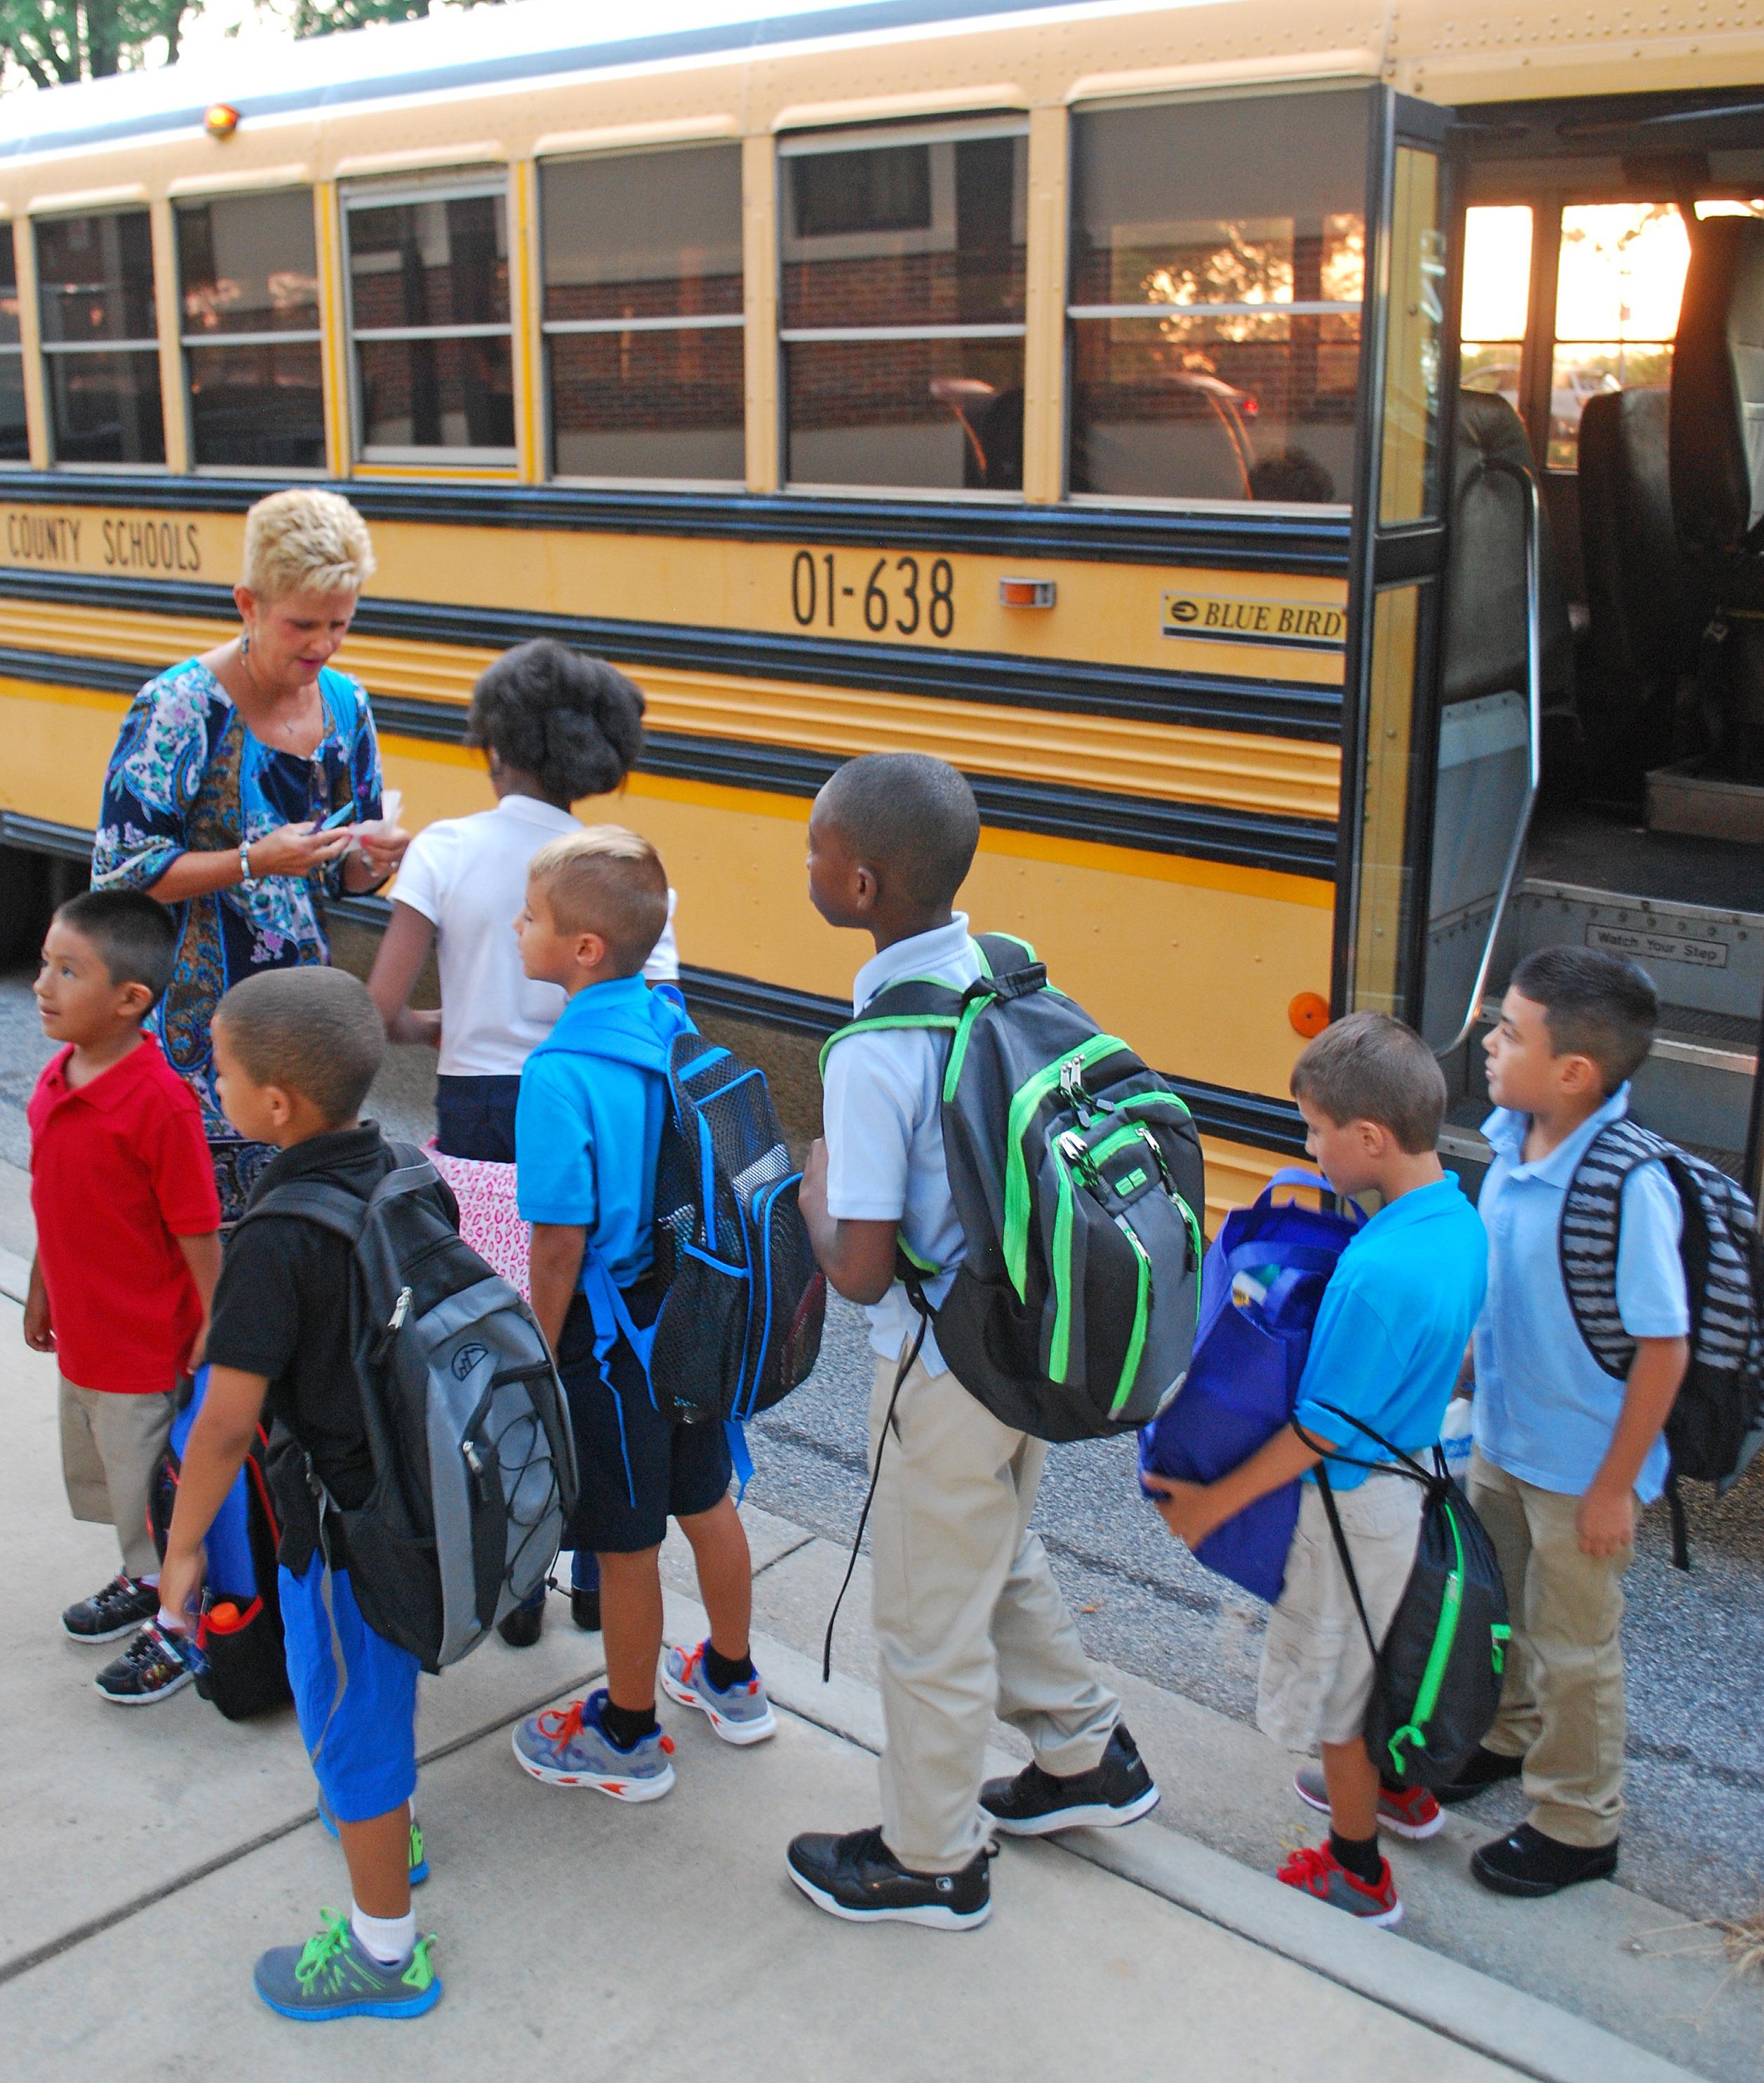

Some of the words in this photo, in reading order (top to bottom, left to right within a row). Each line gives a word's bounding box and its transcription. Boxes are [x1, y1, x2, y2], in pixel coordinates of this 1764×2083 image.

[8, 514, 81, 561] COUNTY
[103, 520, 201, 571] SCHOOLS
[791, 550, 954, 638] 01-638
[1204, 601, 1271, 631] BLUE
[1277, 606, 1342, 637] BIRD
[1597, 931, 1639, 947] Watch
[1646, 938, 1676, 953] Your
[1684, 945, 1717, 961] Step
